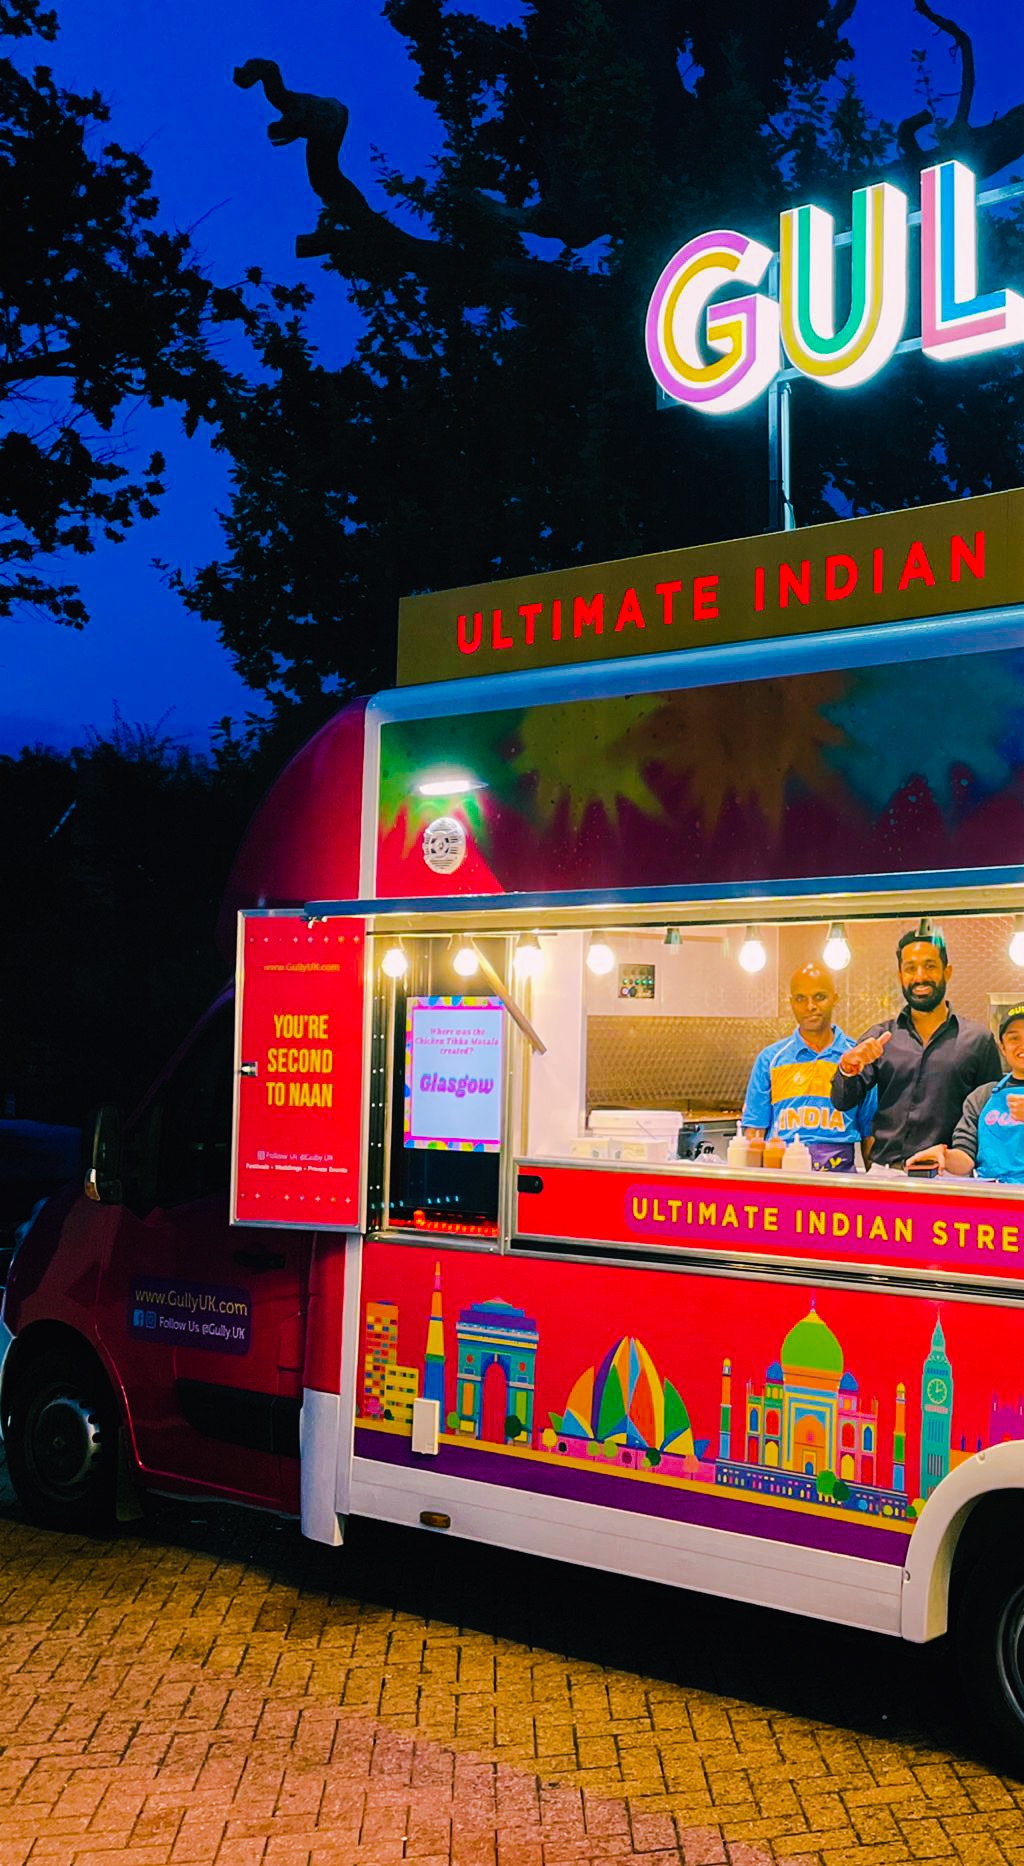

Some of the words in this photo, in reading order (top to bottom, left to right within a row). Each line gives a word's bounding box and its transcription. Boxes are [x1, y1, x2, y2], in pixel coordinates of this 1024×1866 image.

[456, 575, 719, 655] ULTIMATE
[754, 530, 985, 613] INDIAN
[273, 1013, 329, 1039] YOU'RE
[267, 1047, 333, 1073] SECOND
[265, 1081, 286, 1106] TO
[288, 1081, 334, 1108] NAAN
[419, 1071, 495, 1099] Glasgow
[779, 1105, 846, 1132] INDIA
[631, 1196, 779, 1232] ULTIMATE
[795, 1209, 914, 1244] INDIAN
[135, 1289, 248, 1316] www.GullyUK.com
[159, 1316, 187, 1331] Follow
[188, 1320, 200, 1334] Us
